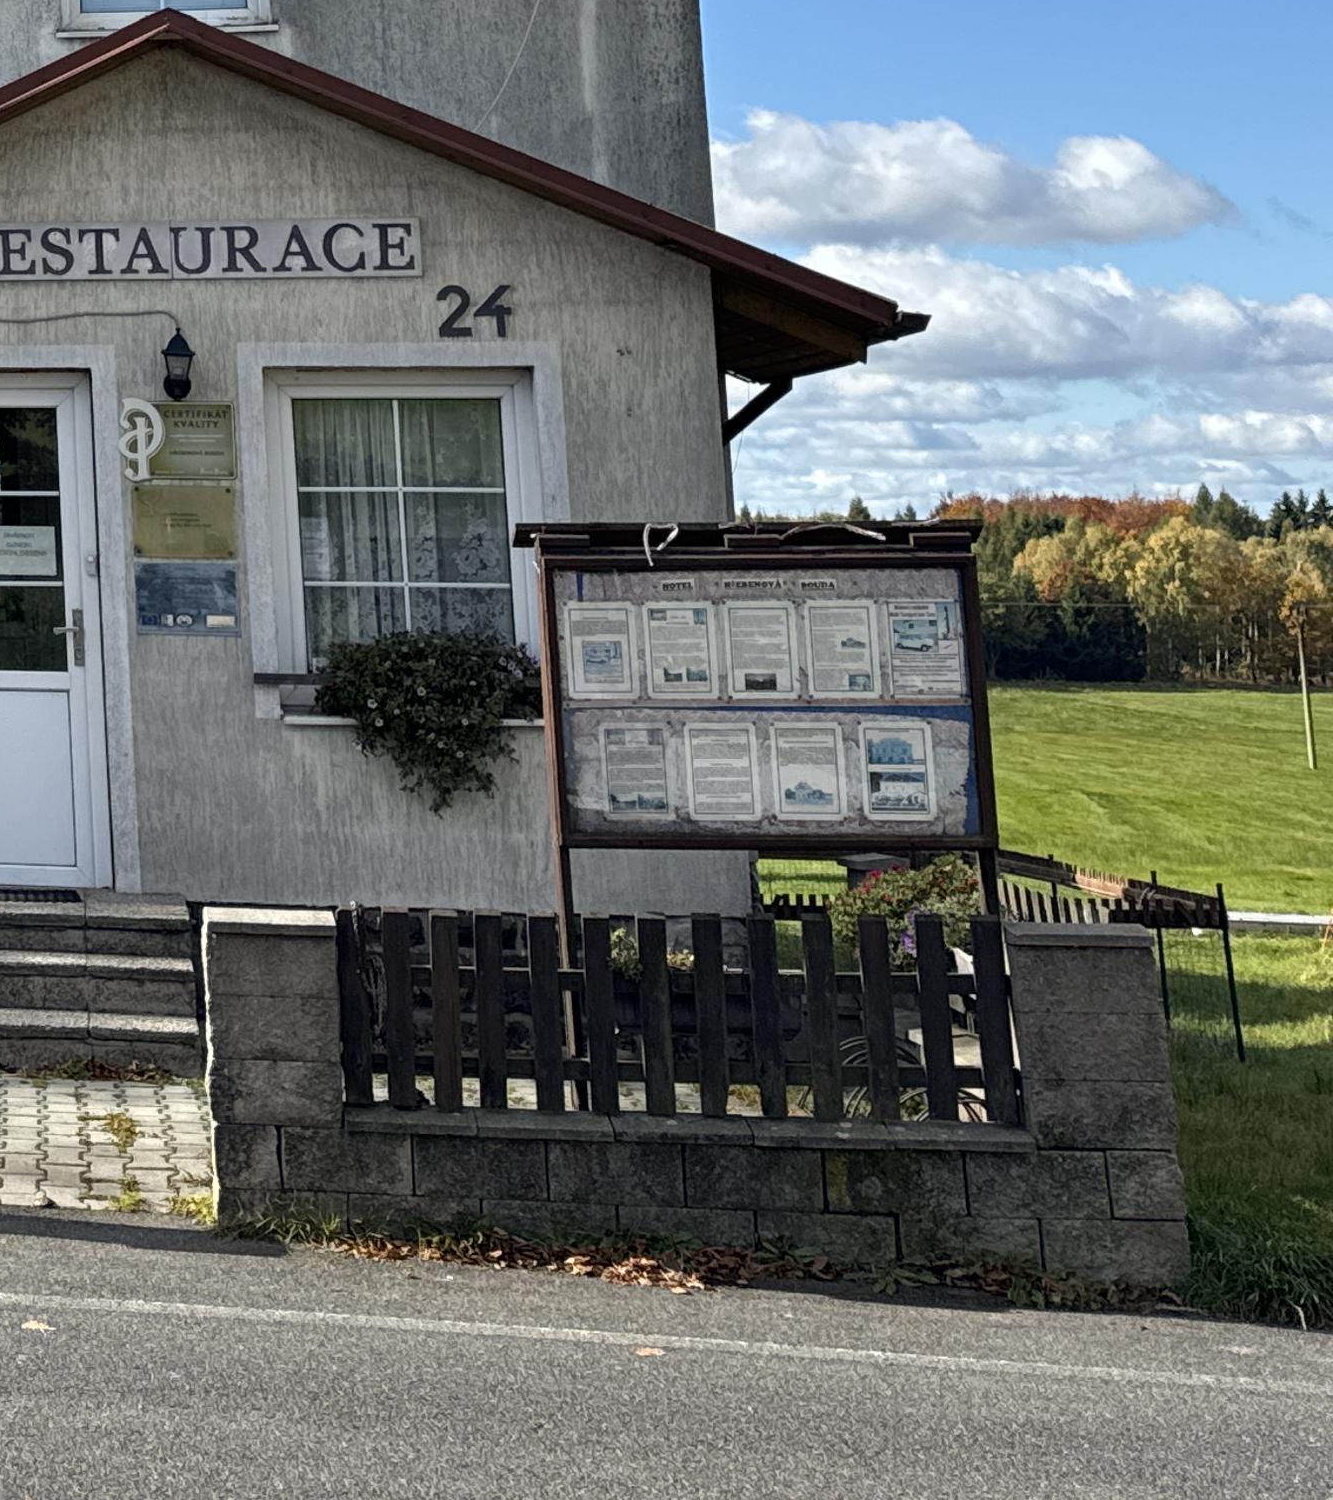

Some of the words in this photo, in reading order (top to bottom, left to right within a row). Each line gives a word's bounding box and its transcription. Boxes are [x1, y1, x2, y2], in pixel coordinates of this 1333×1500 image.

[436, 284, 512, 338] 24
[173, 420, 219, 428] KVALITY
[662, 582, 693, 590] HOTEL
